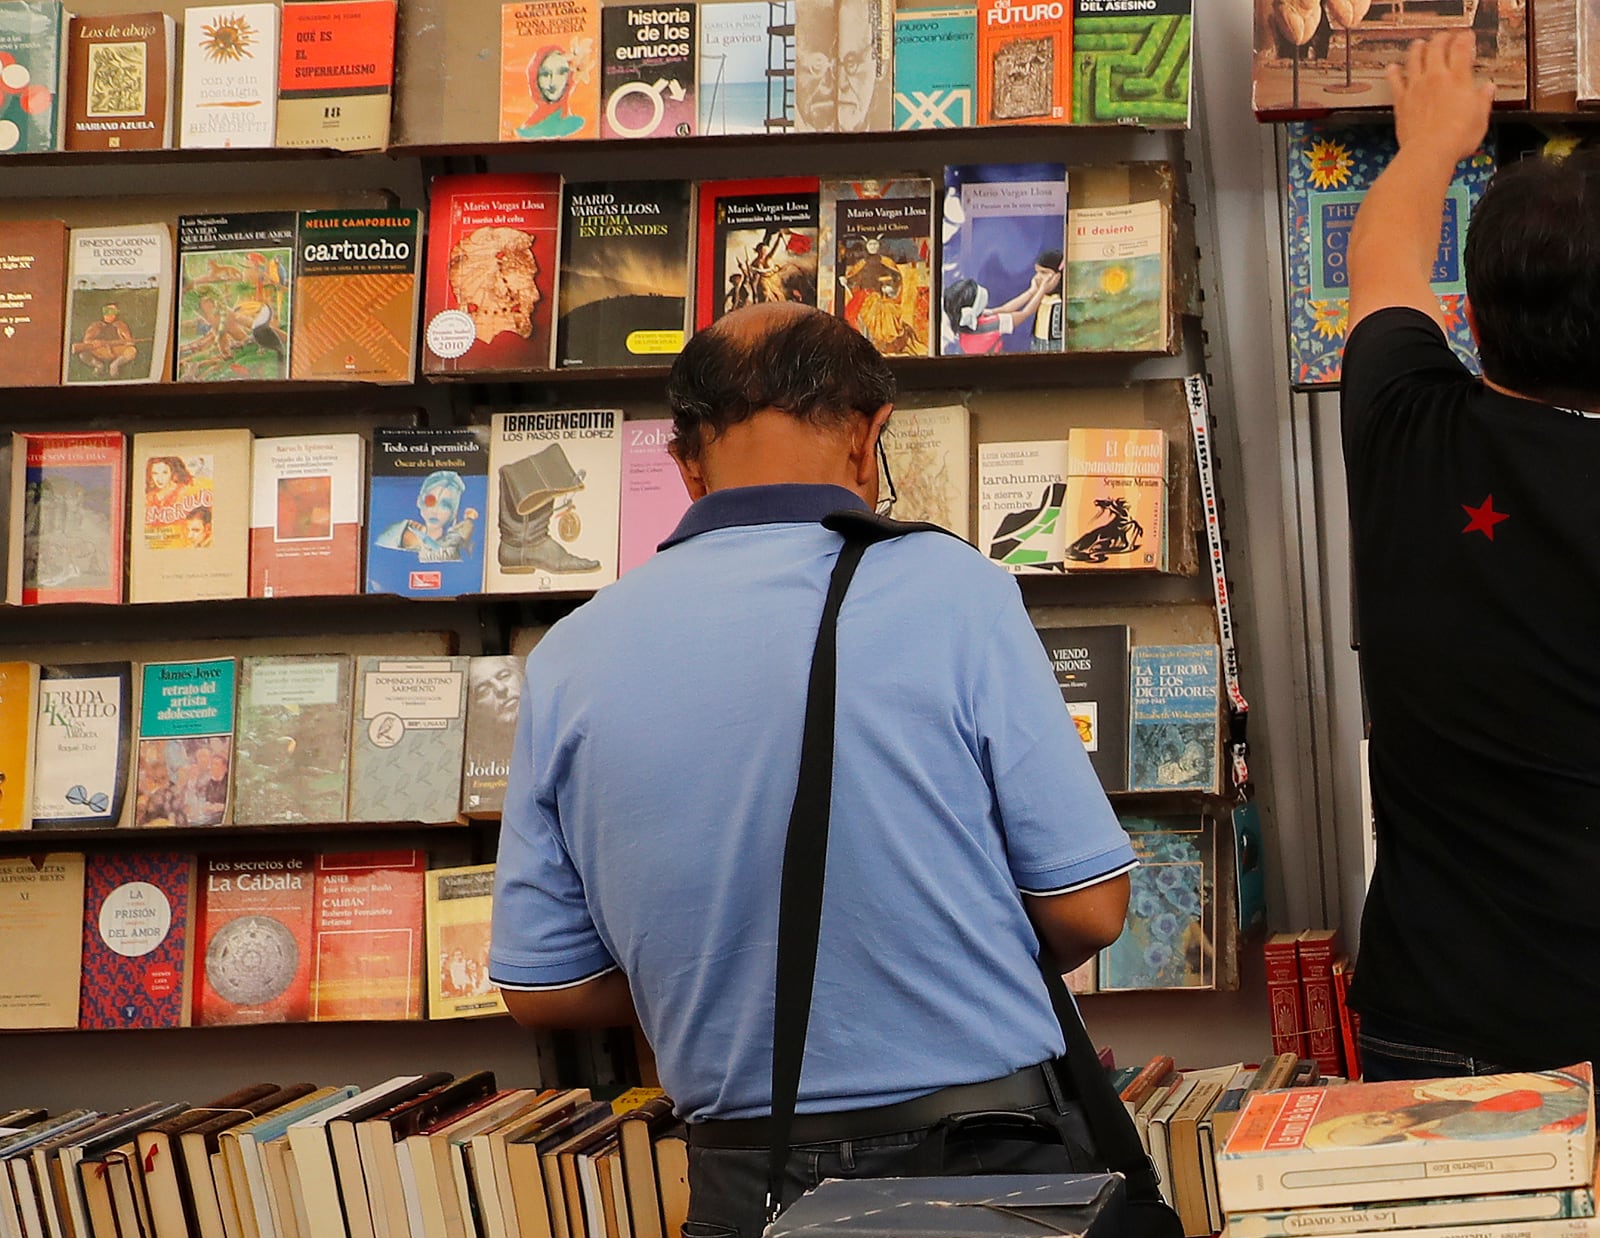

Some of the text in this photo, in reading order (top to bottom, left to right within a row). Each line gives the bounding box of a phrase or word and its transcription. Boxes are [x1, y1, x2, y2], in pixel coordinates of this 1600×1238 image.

[627, 8, 690, 27] historia
[986, 3, 1063, 24] FUTURO
[80, 23, 156, 39] Los de abajo
[637, 25, 689, 40] de los
[616, 42, 690, 60] eunucos
[295, 63, 376, 78] SUPERREALISMO
[76, 120, 154, 131] MARIANO AZUELA
[572, 194, 614, 206] MARIO
[571, 203, 661, 216] VARGAS LLOSA
[306, 218, 411, 228] NELLIE CAMPOBELLO
[579, 214, 629, 227] LITUMA
[580, 223, 668, 237] EN LOS ANDES
[304, 240, 409, 264] cartucho
[502, 411, 614, 432] IBARGÜENGOITIA
[502, 432, 524, 442] LOS
[528, 431, 560, 441] PASOS
[564, 430, 578, 440] DE
[382, 441, 479, 455] Todo está permitido
[983, 473, 1062, 484] tarahumara
[1136, 665, 1208, 676] LA EUROPA
[1136, 676, 1183, 686] DE LOS
[1136, 686, 1216, 698] DICTADORES
[209, 858, 302, 871] Los secretos de
[209, 873, 302, 892] La Cábala
[129, 890, 143, 900] LA
[115, 906, 156, 920] PRISIÓN
[108, 927, 160, 938] DEL AMOR
